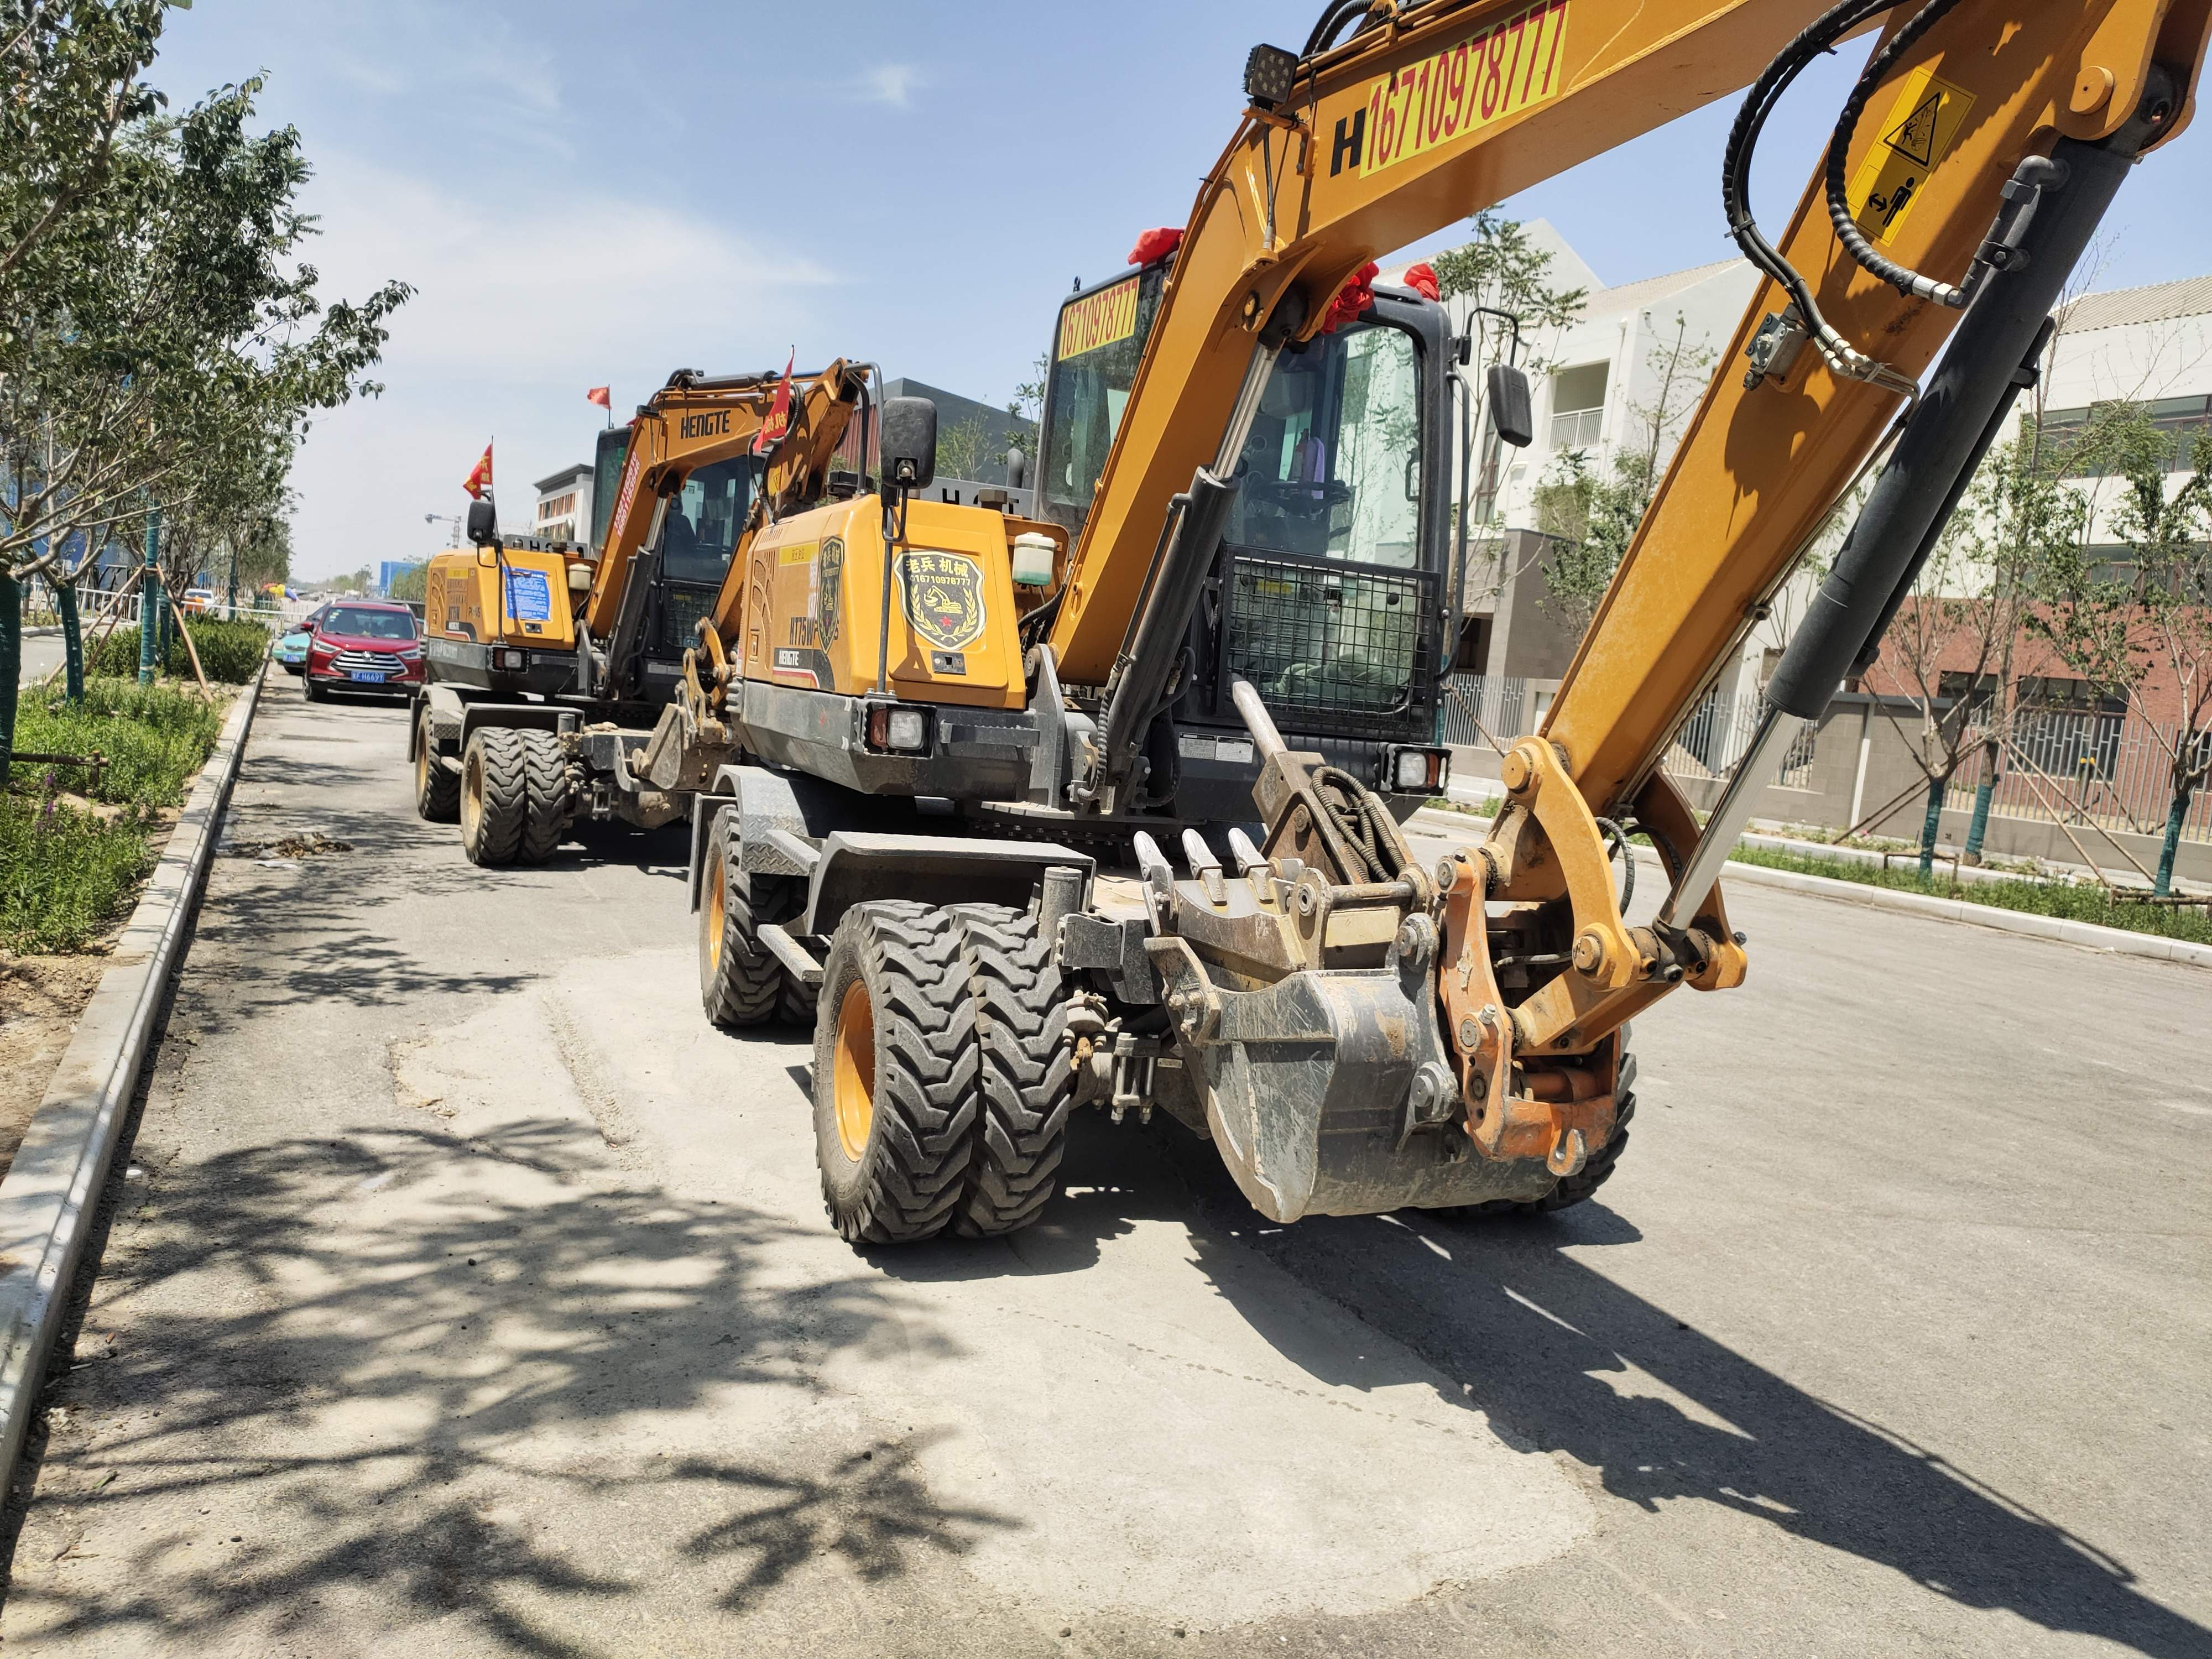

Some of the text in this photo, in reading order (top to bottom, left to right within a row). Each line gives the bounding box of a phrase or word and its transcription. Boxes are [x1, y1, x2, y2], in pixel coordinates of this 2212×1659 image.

[1367, 0, 1568, 170] 16710978777
[1061, 278, 1138, 357] 16710978777
[680, 409, 732, 440] HENGTE
[905, 556, 969, 577] 老兵 机械
[915, 575, 971, 586] 16710978777
[779, 649, 800, 666] HENGTE
